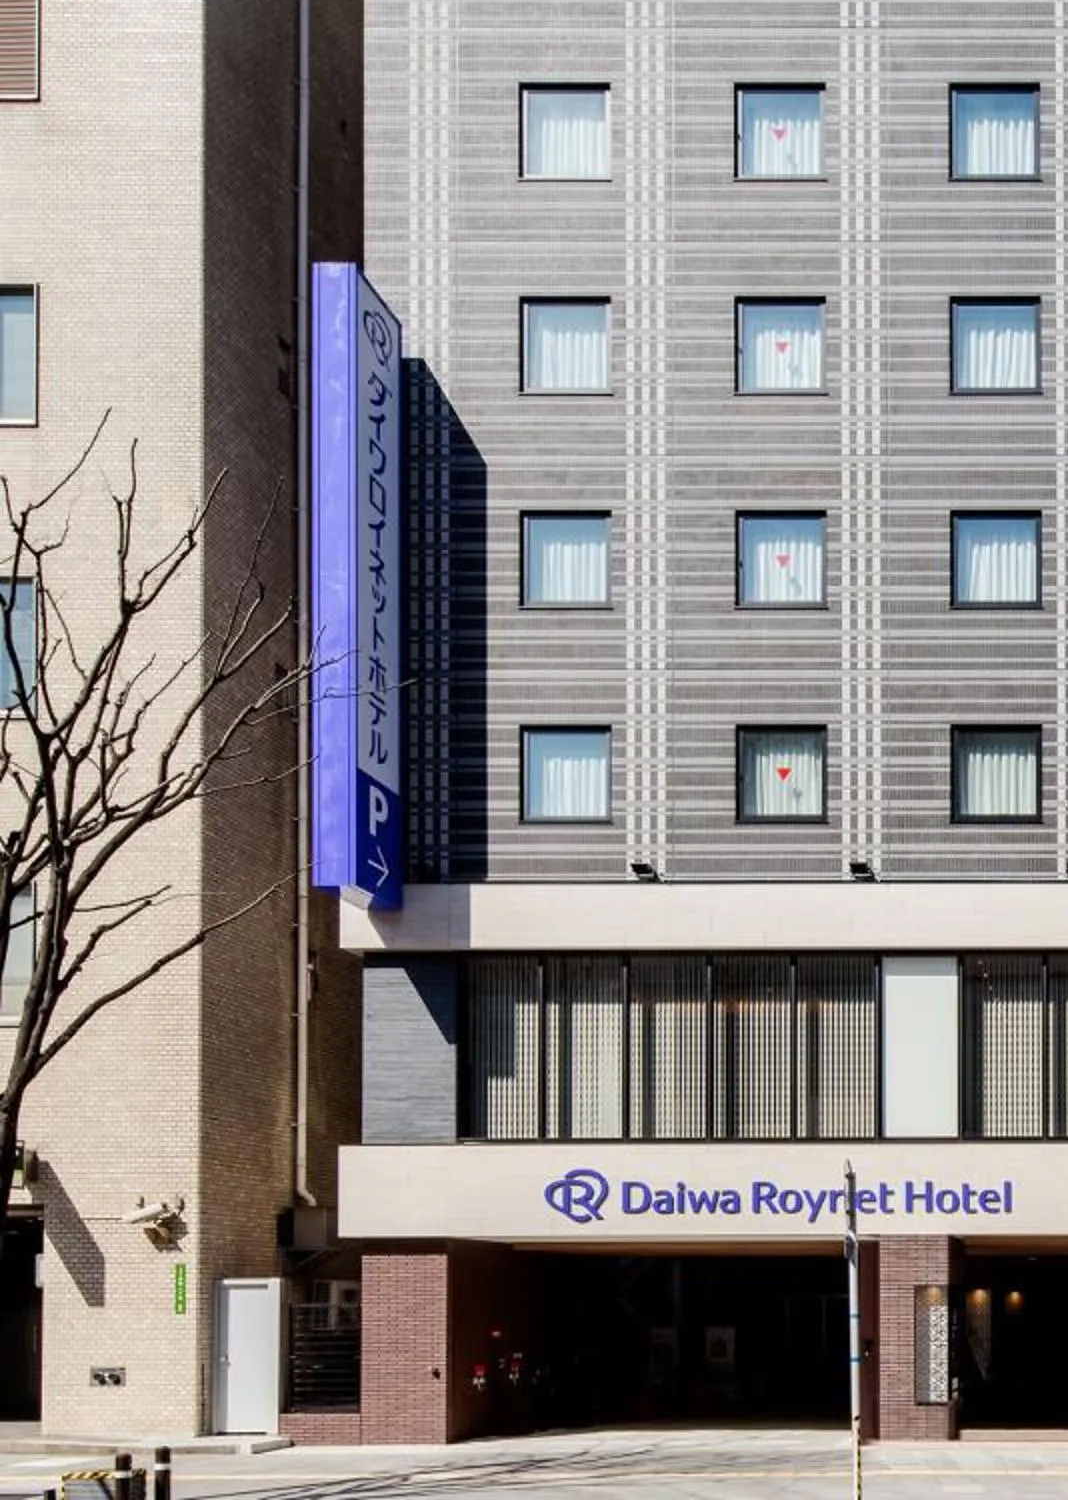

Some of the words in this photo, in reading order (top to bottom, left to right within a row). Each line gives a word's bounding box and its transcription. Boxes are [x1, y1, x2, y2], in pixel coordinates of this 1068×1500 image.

[367, 371, 392, 765] ダイワロイネットホテル
[369, 785, 389, 836] P
[621, 1181, 741, 1215] Daiwa
[904, 1181, 1013, 1215] Hotel
